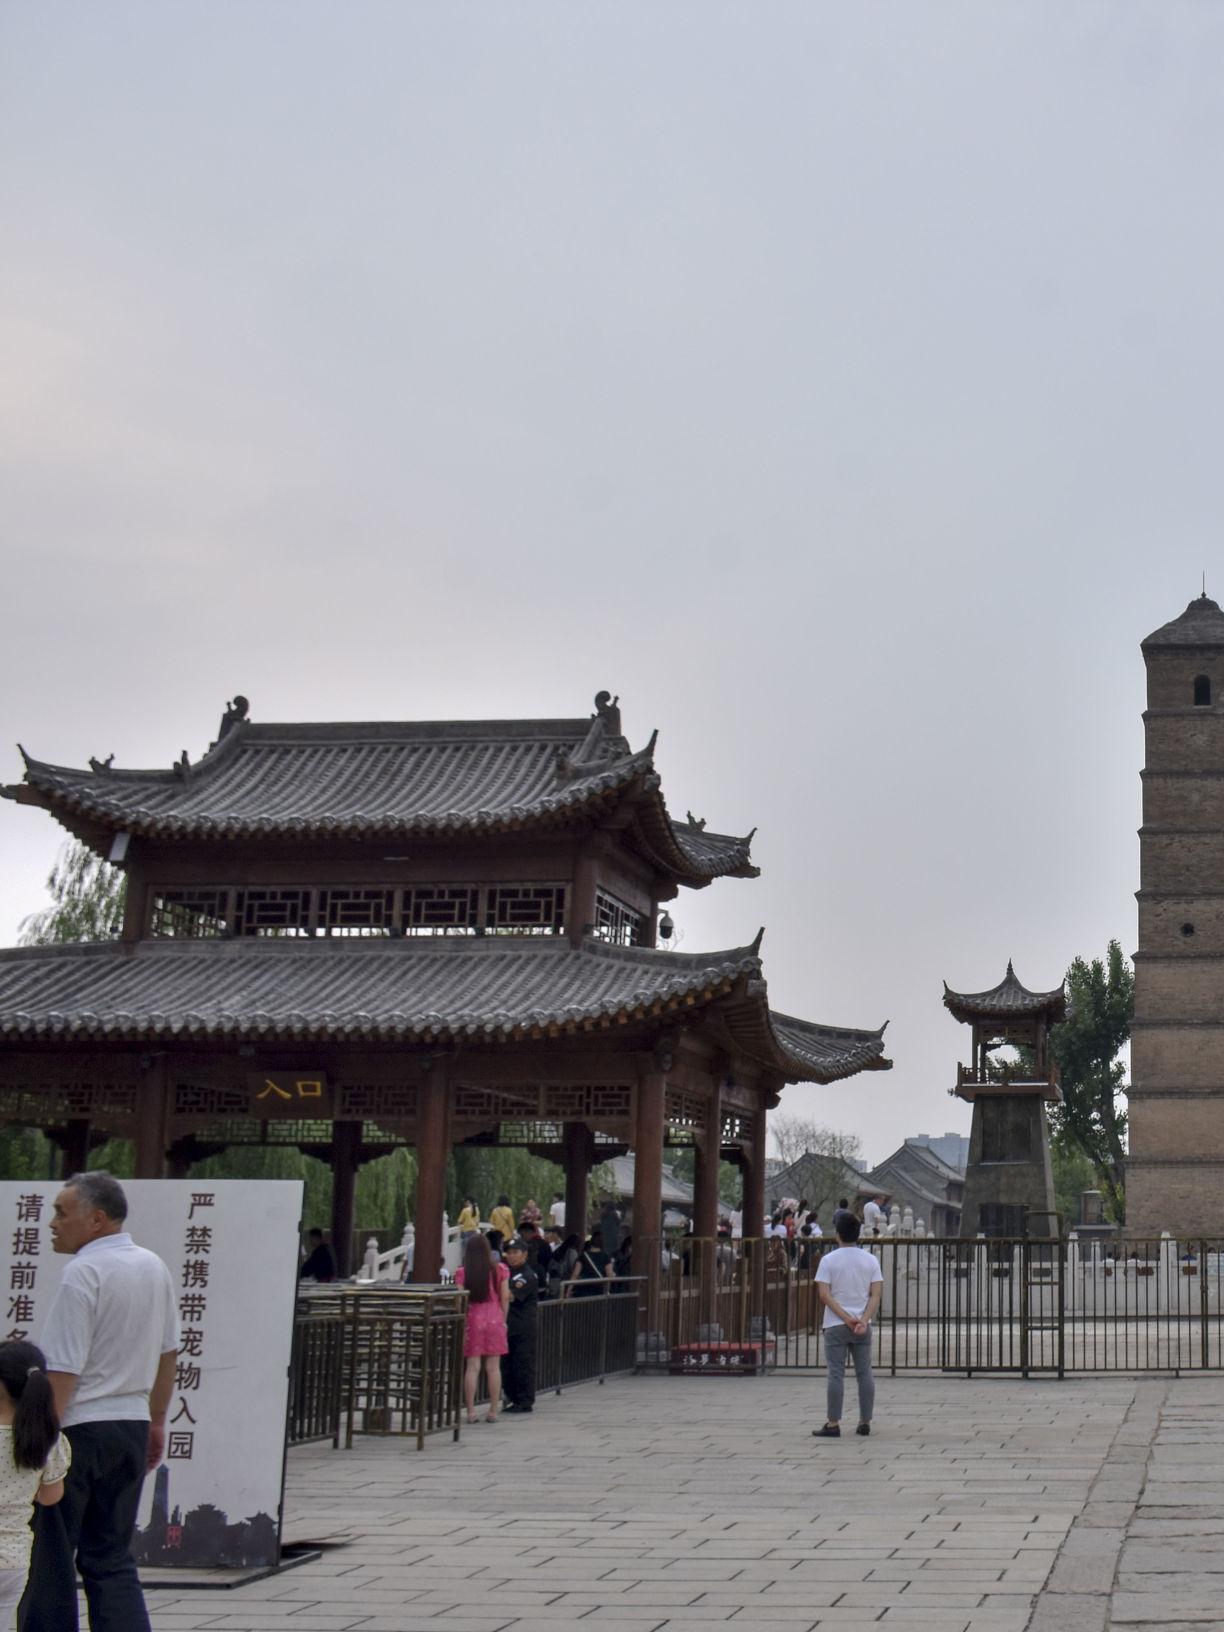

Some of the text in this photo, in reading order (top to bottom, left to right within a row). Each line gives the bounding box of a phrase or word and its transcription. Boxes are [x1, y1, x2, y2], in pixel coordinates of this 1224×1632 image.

[256, 1079, 322, 1100] 入口
[167, 1193, 215, 1460] 严禁携带宠物入园
